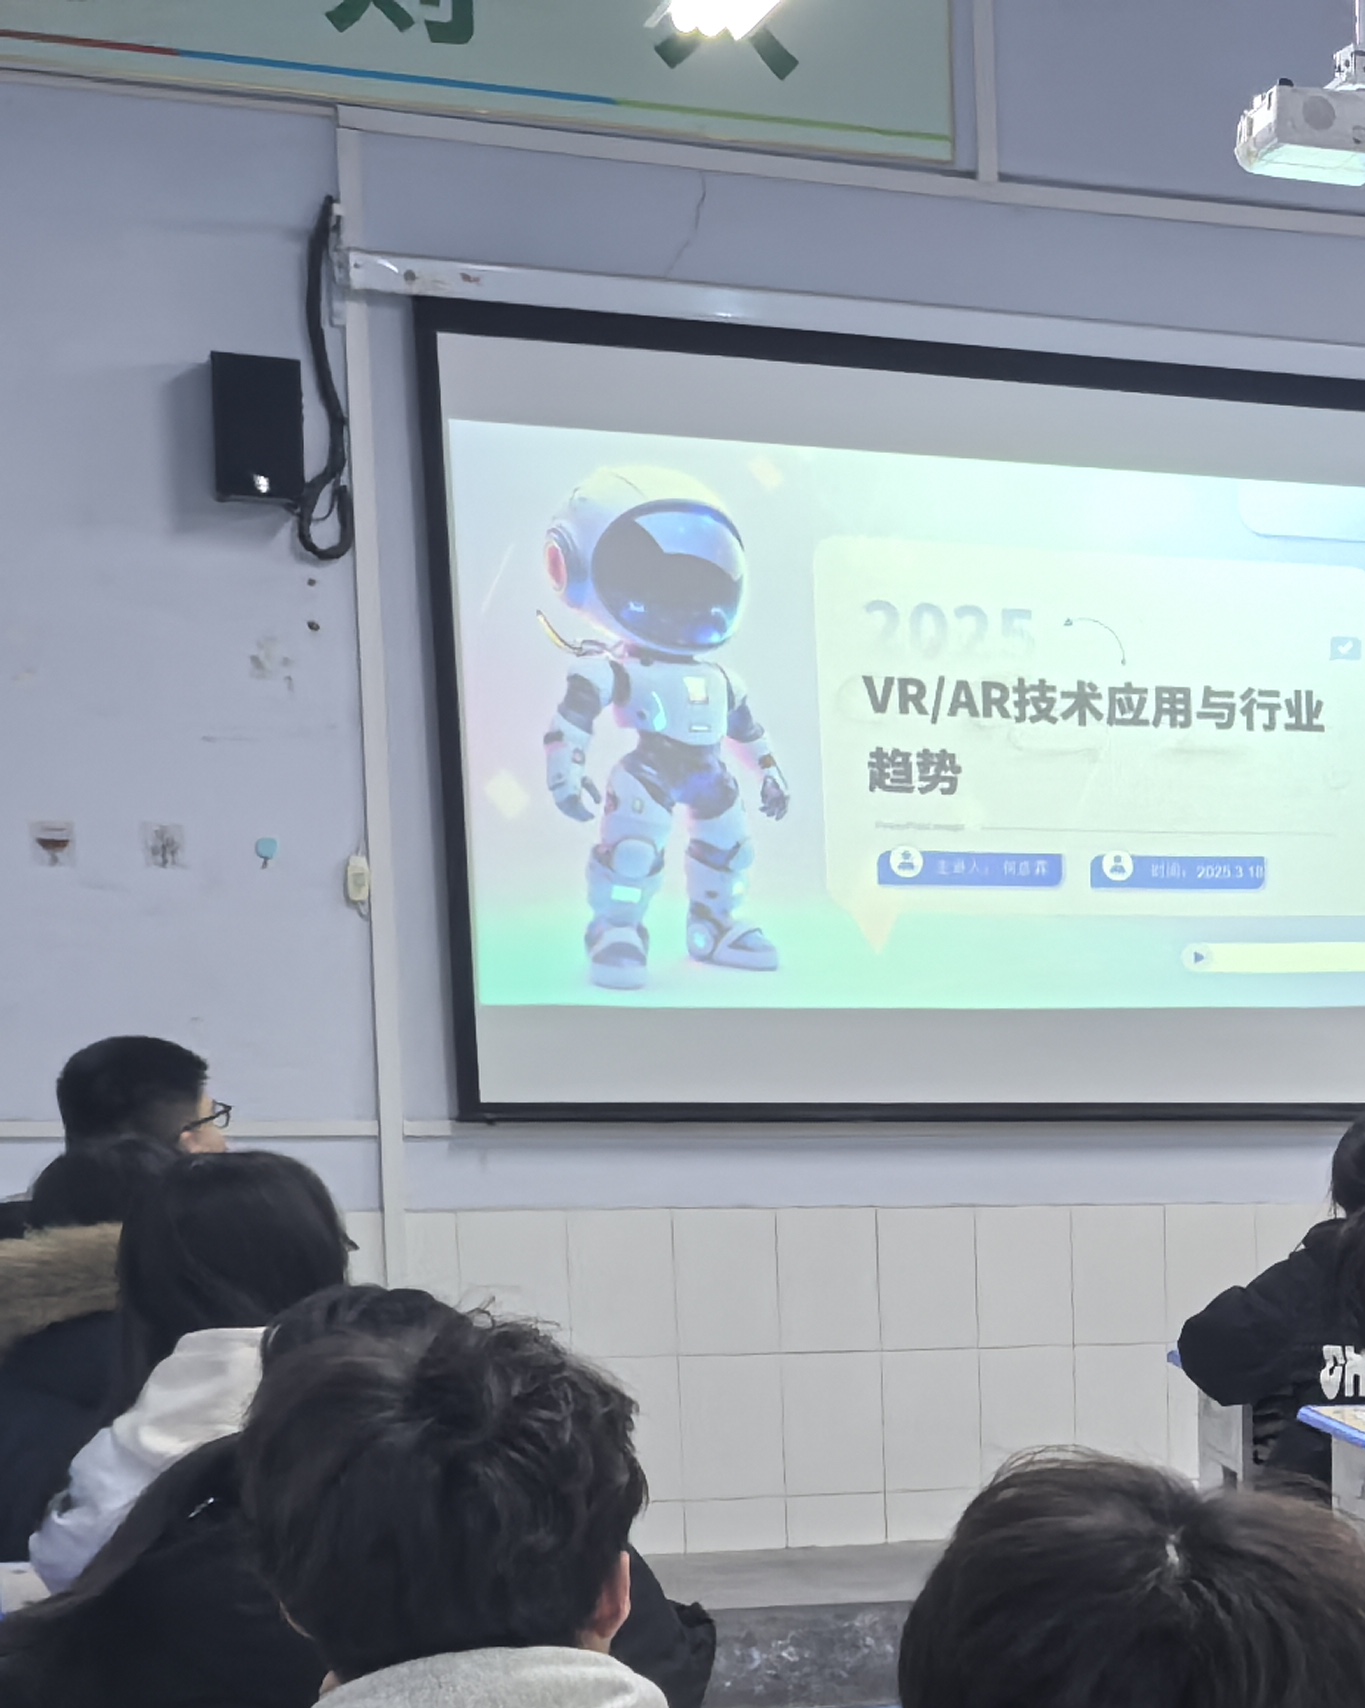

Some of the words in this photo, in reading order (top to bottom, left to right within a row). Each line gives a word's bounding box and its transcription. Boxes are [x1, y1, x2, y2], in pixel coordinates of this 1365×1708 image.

[864, 600, 1036, 662] 2025
[862, 675, 1326, 733] VR/AR技术应用与行业
[867, 747, 963, 797] 趋势
